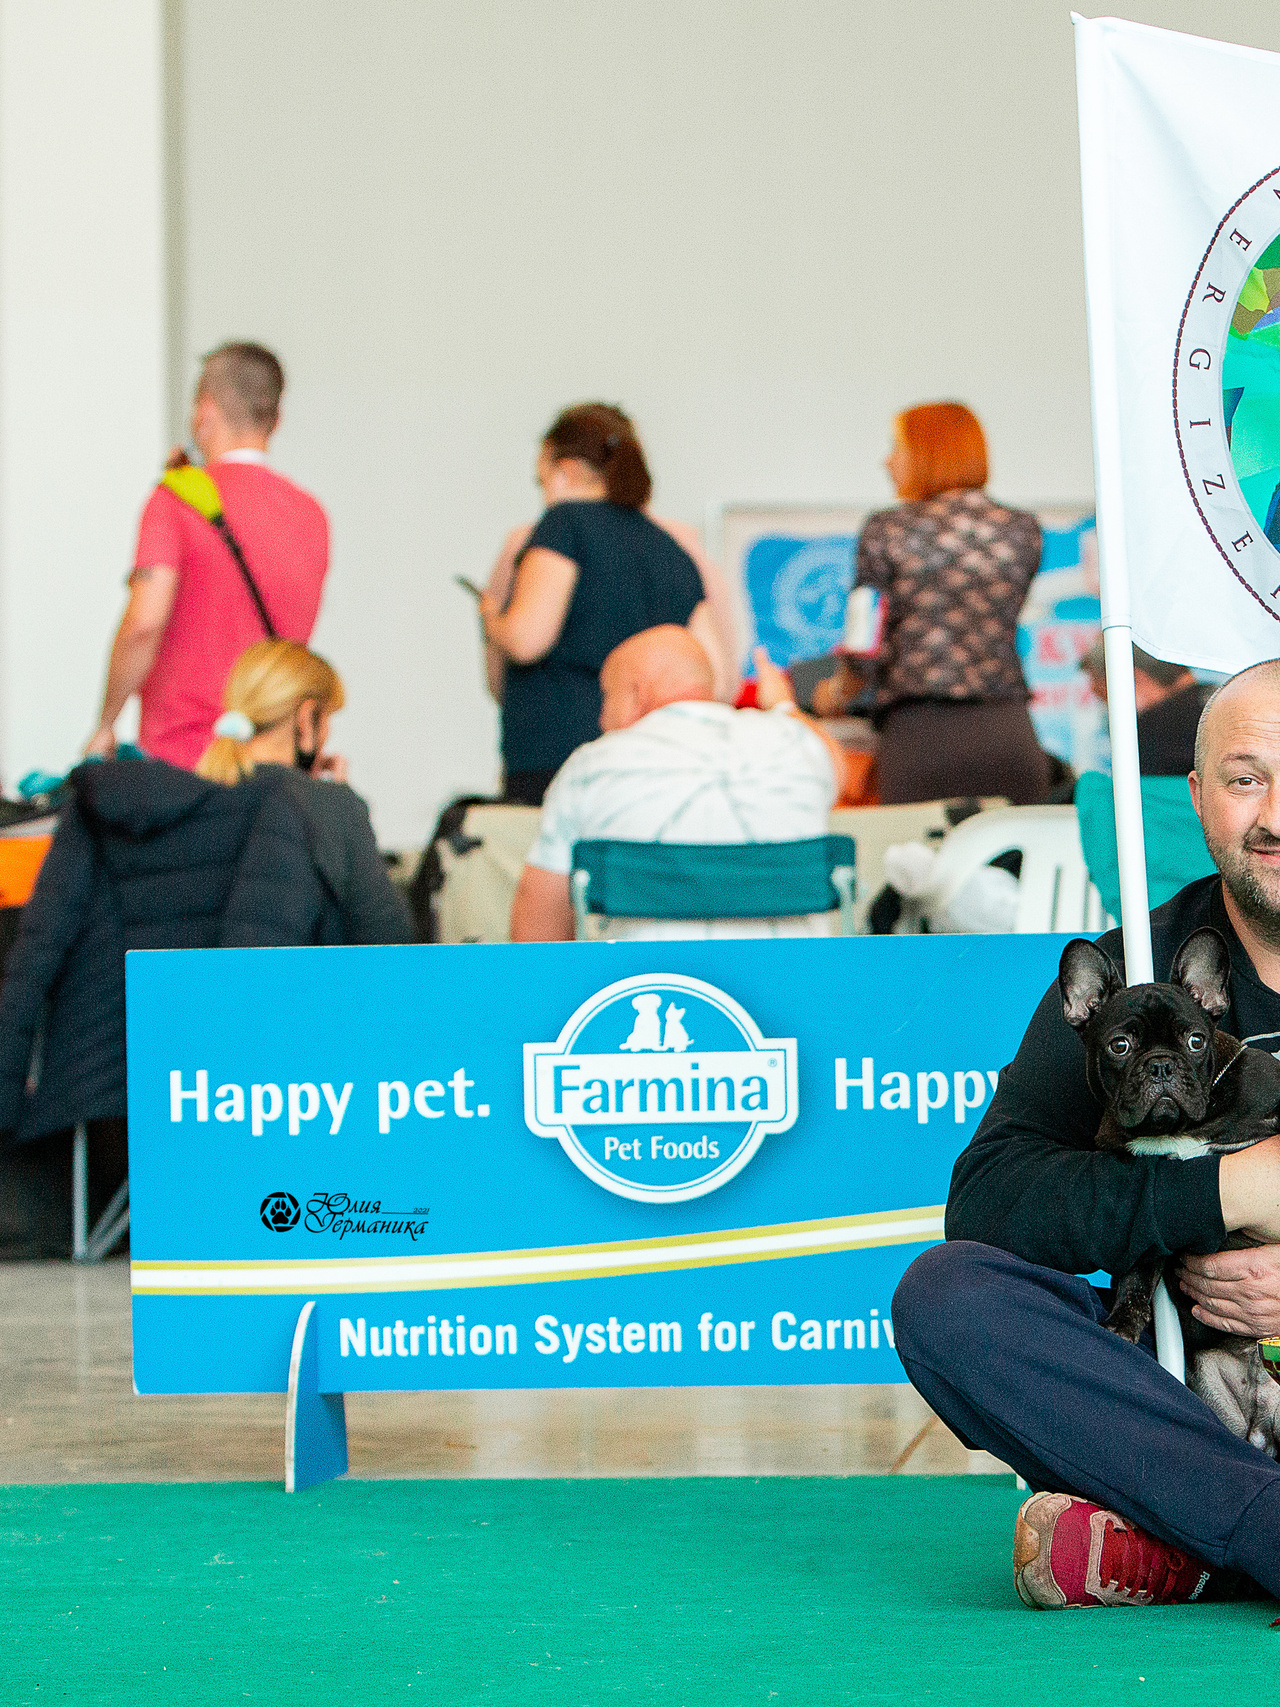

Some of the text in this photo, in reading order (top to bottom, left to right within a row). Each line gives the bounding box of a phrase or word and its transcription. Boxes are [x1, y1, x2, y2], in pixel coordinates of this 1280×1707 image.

[169, 1067, 490, 1137] Happy pet.
[553, 1062, 769, 1114] Farmina
[834, 1057, 998, 1124] Happ
[604, 1135, 720, 1160] Pet Foods
[339, 1315, 517, 1357] Nutrition
[534, 1314, 682, 1363] System
[697, 1312, 756, 1352] for
